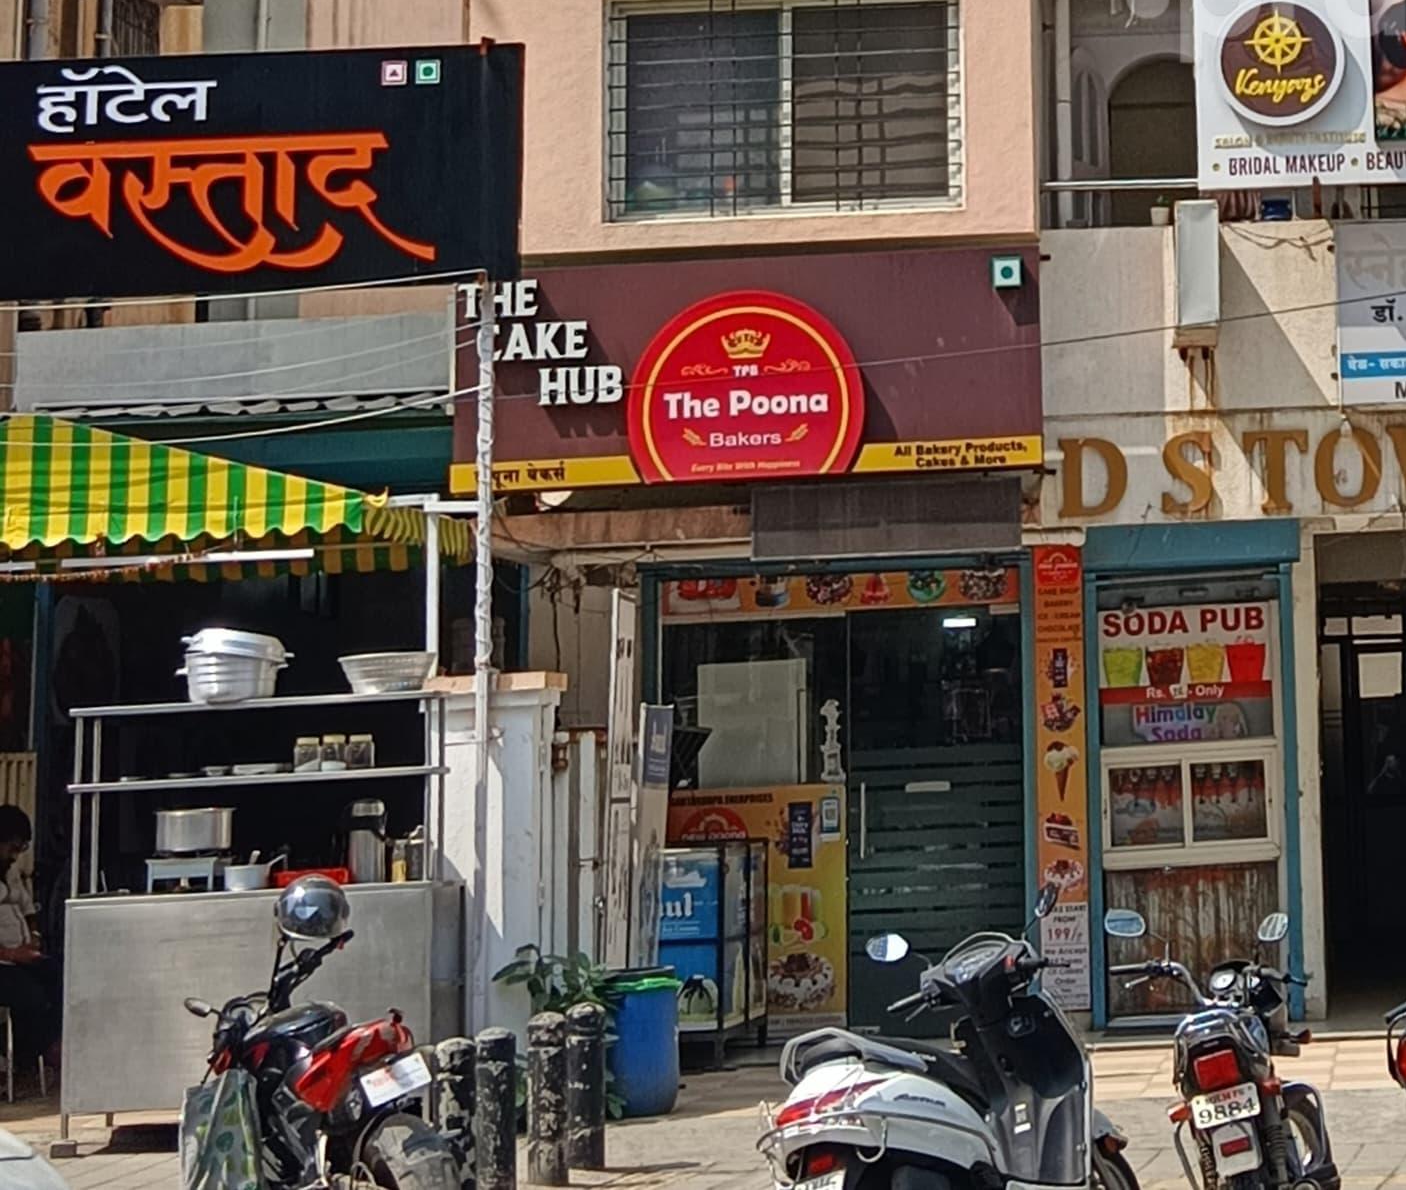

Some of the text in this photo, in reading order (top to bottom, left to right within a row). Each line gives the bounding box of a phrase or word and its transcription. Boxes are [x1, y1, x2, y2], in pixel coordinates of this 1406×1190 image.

[35, 65, 218, 133] हॉटेल
[1228, 155, 1282, 176] BRIDAL
[1285, 152, 1346, 174] MAKEUP
[26, 131, 437, 274] वस्ताद
[1372, 298, 1403, 323] डॉ.
[536, 365, 625, 408] HUB
[663, 390, 829, 419] The Poona
[709, 432, 783, 448] Bakers
[894, 440, 1028, 458] All Bakery Products,
[916, 454, 1008, 468] Cakes & More
[1058, 437, 1130, 519] D
[1160, 430, 1219, 518] S
[1103, 606, 1265, 638] SODA PUB
[1146, 687, 1168, 699] Rs.
[1195, 685, 1225, 698] Only
[1135, 702, 1218, 725] Himalay
[1151, 725, 1203, 741] Soda
[1199, 1098, 1257, 1127] 9884
